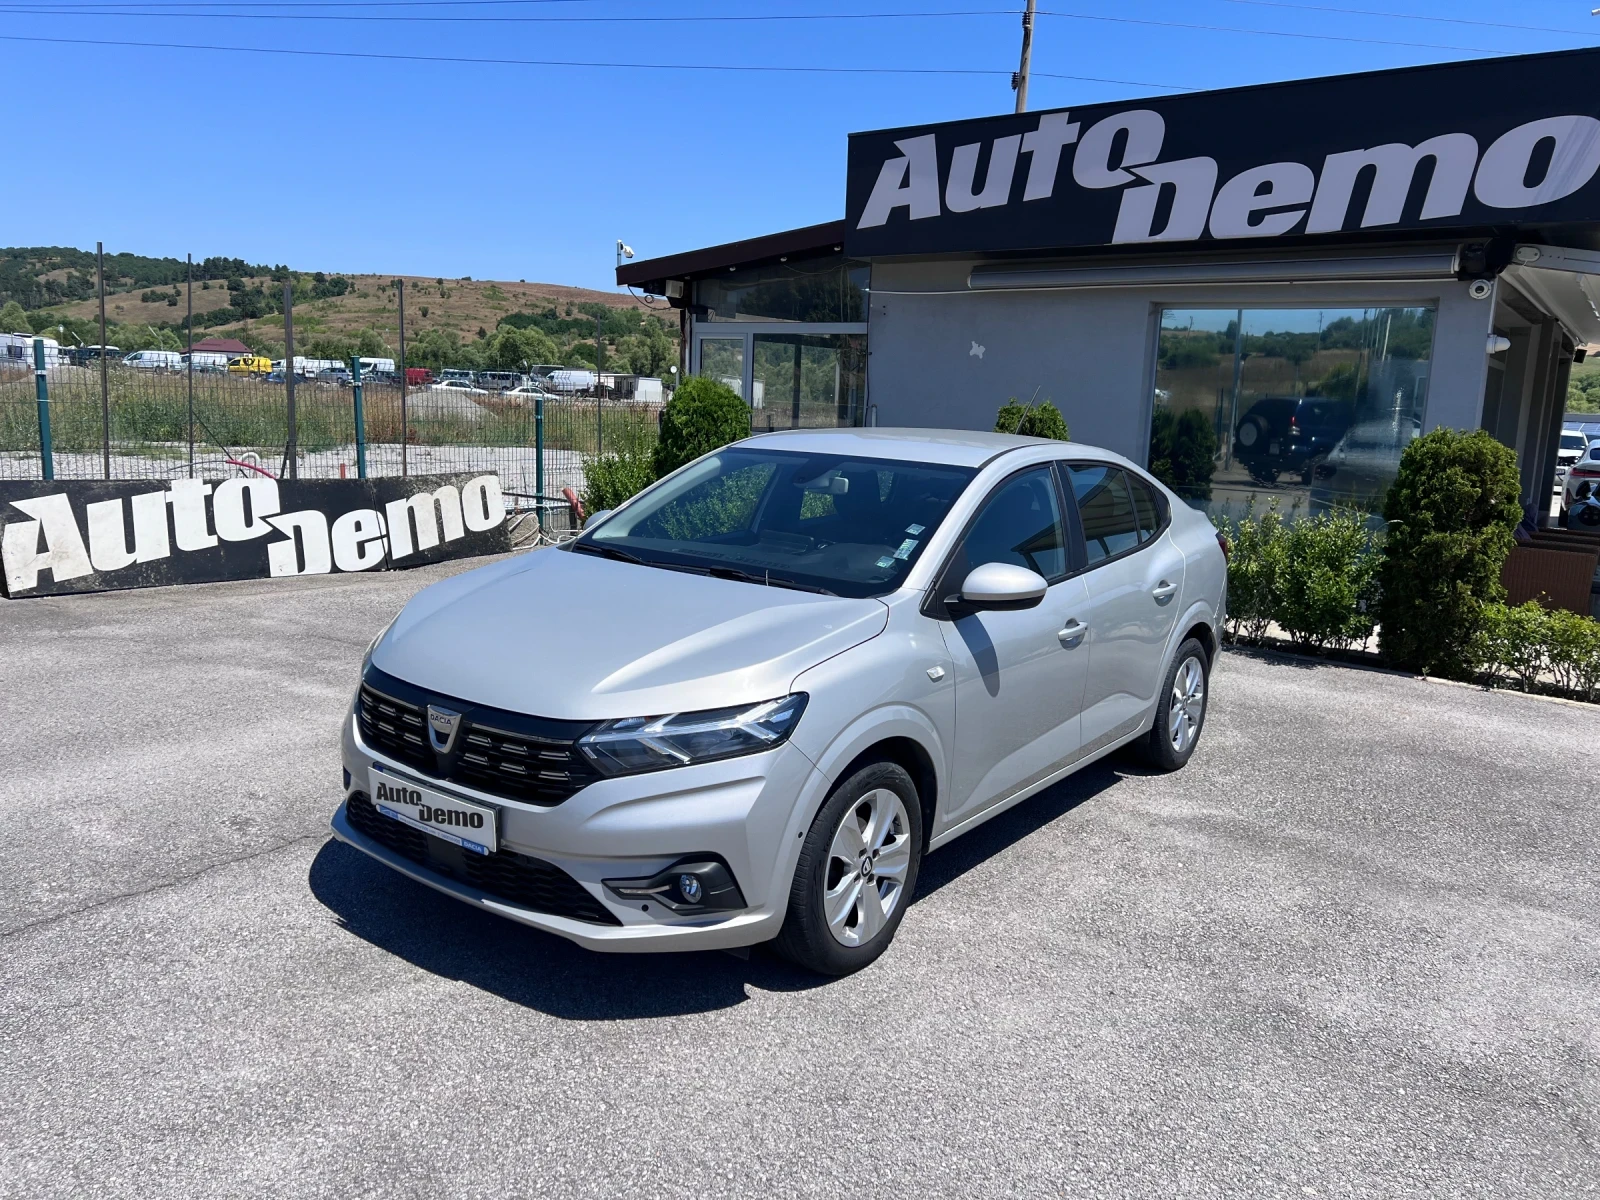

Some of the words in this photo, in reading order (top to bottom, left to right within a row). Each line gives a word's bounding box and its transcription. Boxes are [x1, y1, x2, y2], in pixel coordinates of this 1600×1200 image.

[857, 109, 1165, 229] Auto
[1112, 115, 1600, 244] Demo
[2, 477, 281, 592] Auto
[266, 475, 506, 578] Demo
[430, 713, 452, 725] DACIA
[376, 782, 422, 806] Auto
[418, 803, 484, 829] Demo
[463, 840, 483, 853] DACIA
